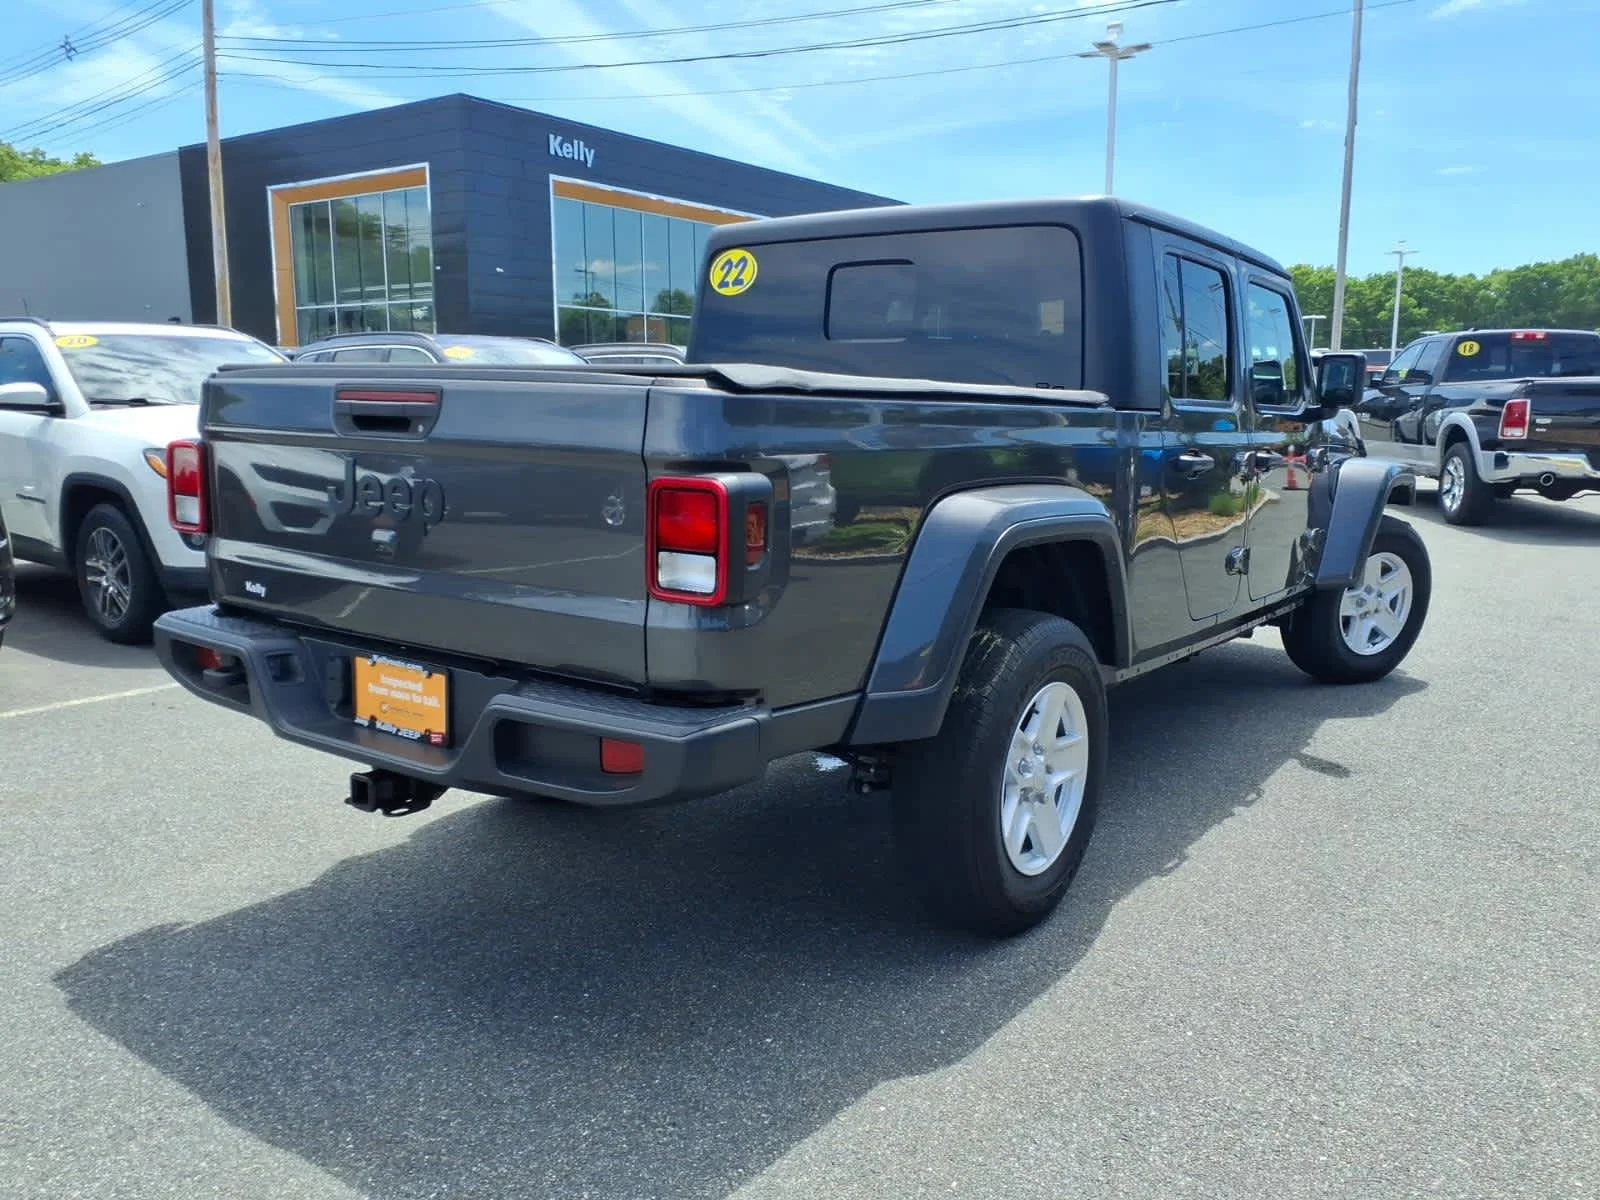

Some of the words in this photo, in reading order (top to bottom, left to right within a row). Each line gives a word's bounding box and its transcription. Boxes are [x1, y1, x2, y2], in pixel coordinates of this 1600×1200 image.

[549, 133, 595, 168] Kelly
[717, 255, 748, 289] 22
[1463, 343, 1474, 354] 18
[327, 457, 446, 537] Jeep
[245, 580, 267, 597] Kelly
